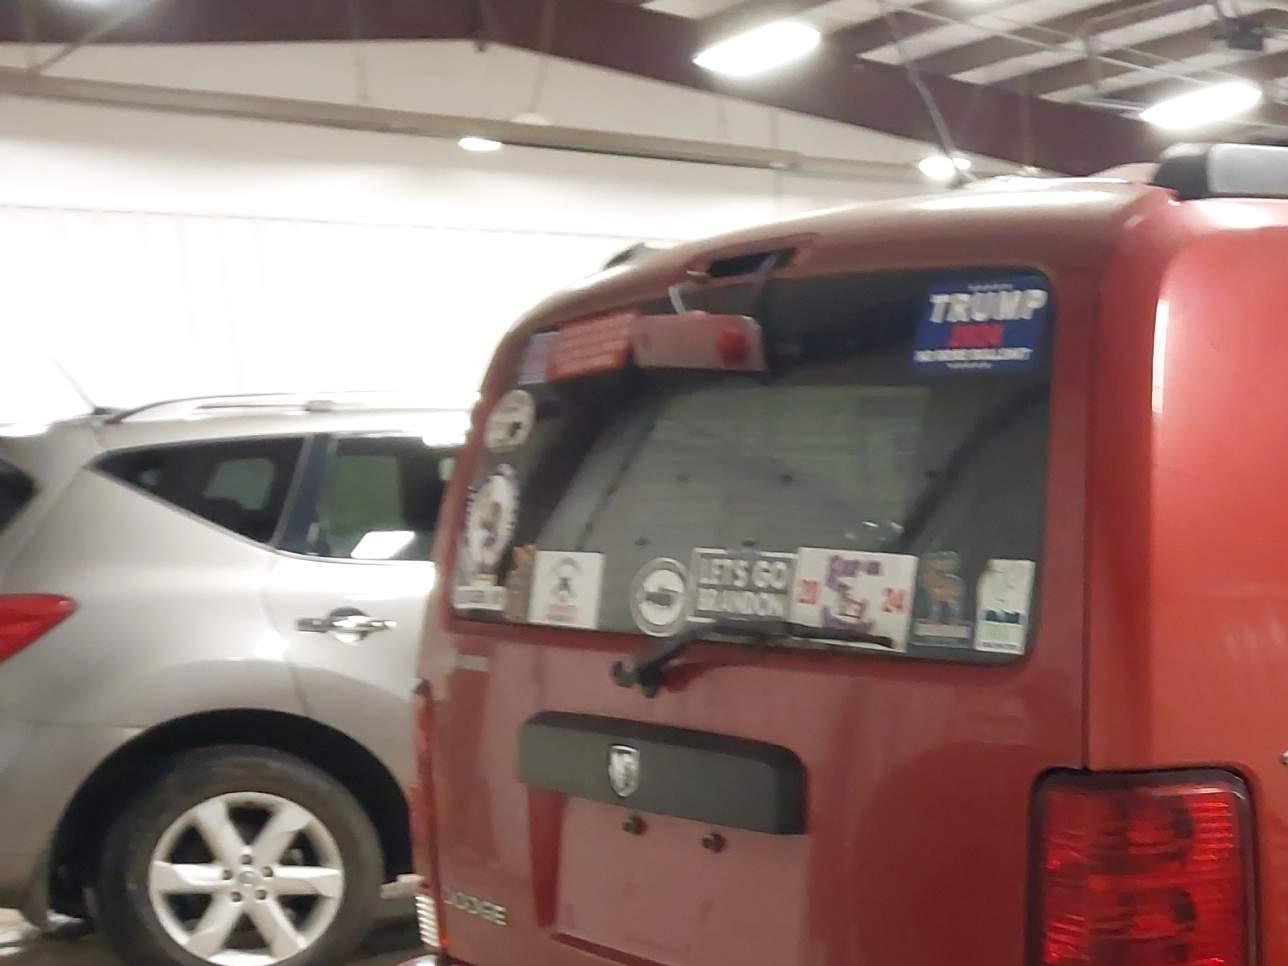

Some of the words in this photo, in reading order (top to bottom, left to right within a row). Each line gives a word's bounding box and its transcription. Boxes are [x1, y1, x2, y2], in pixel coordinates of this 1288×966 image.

[929, 289, 1048, 323] TRUMP
[753, 559, 788, 589] GO
[443, 888, 507, 926] DODGE
